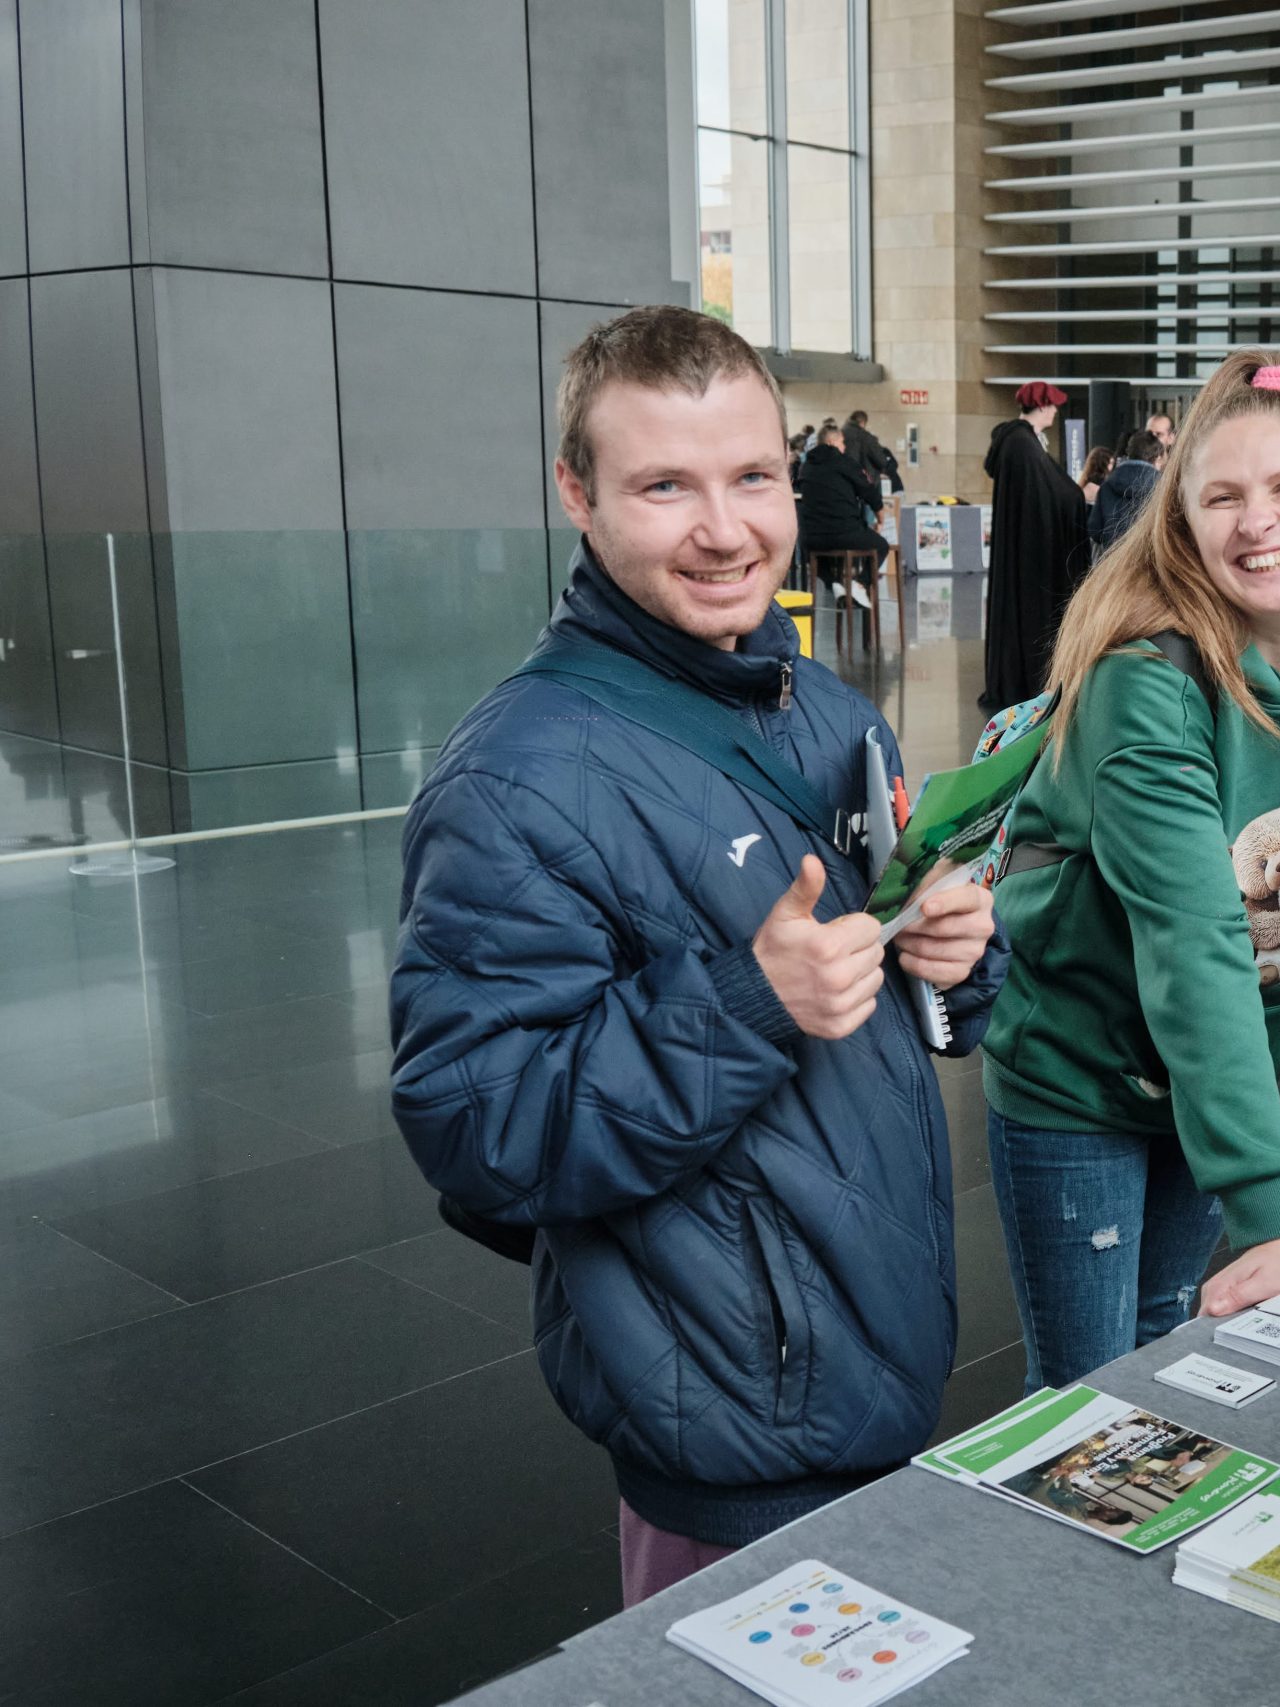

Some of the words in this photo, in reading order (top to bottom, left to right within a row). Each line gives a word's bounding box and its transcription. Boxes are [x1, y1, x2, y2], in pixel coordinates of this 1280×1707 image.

[1112, 1427, 1168, 1460] Formación
[1125, 1431, 1178, 1462] Programa
[1066, 1460, 1111, 1485] Emplo
[1196, 1475, 1240, 1503] pioneros
